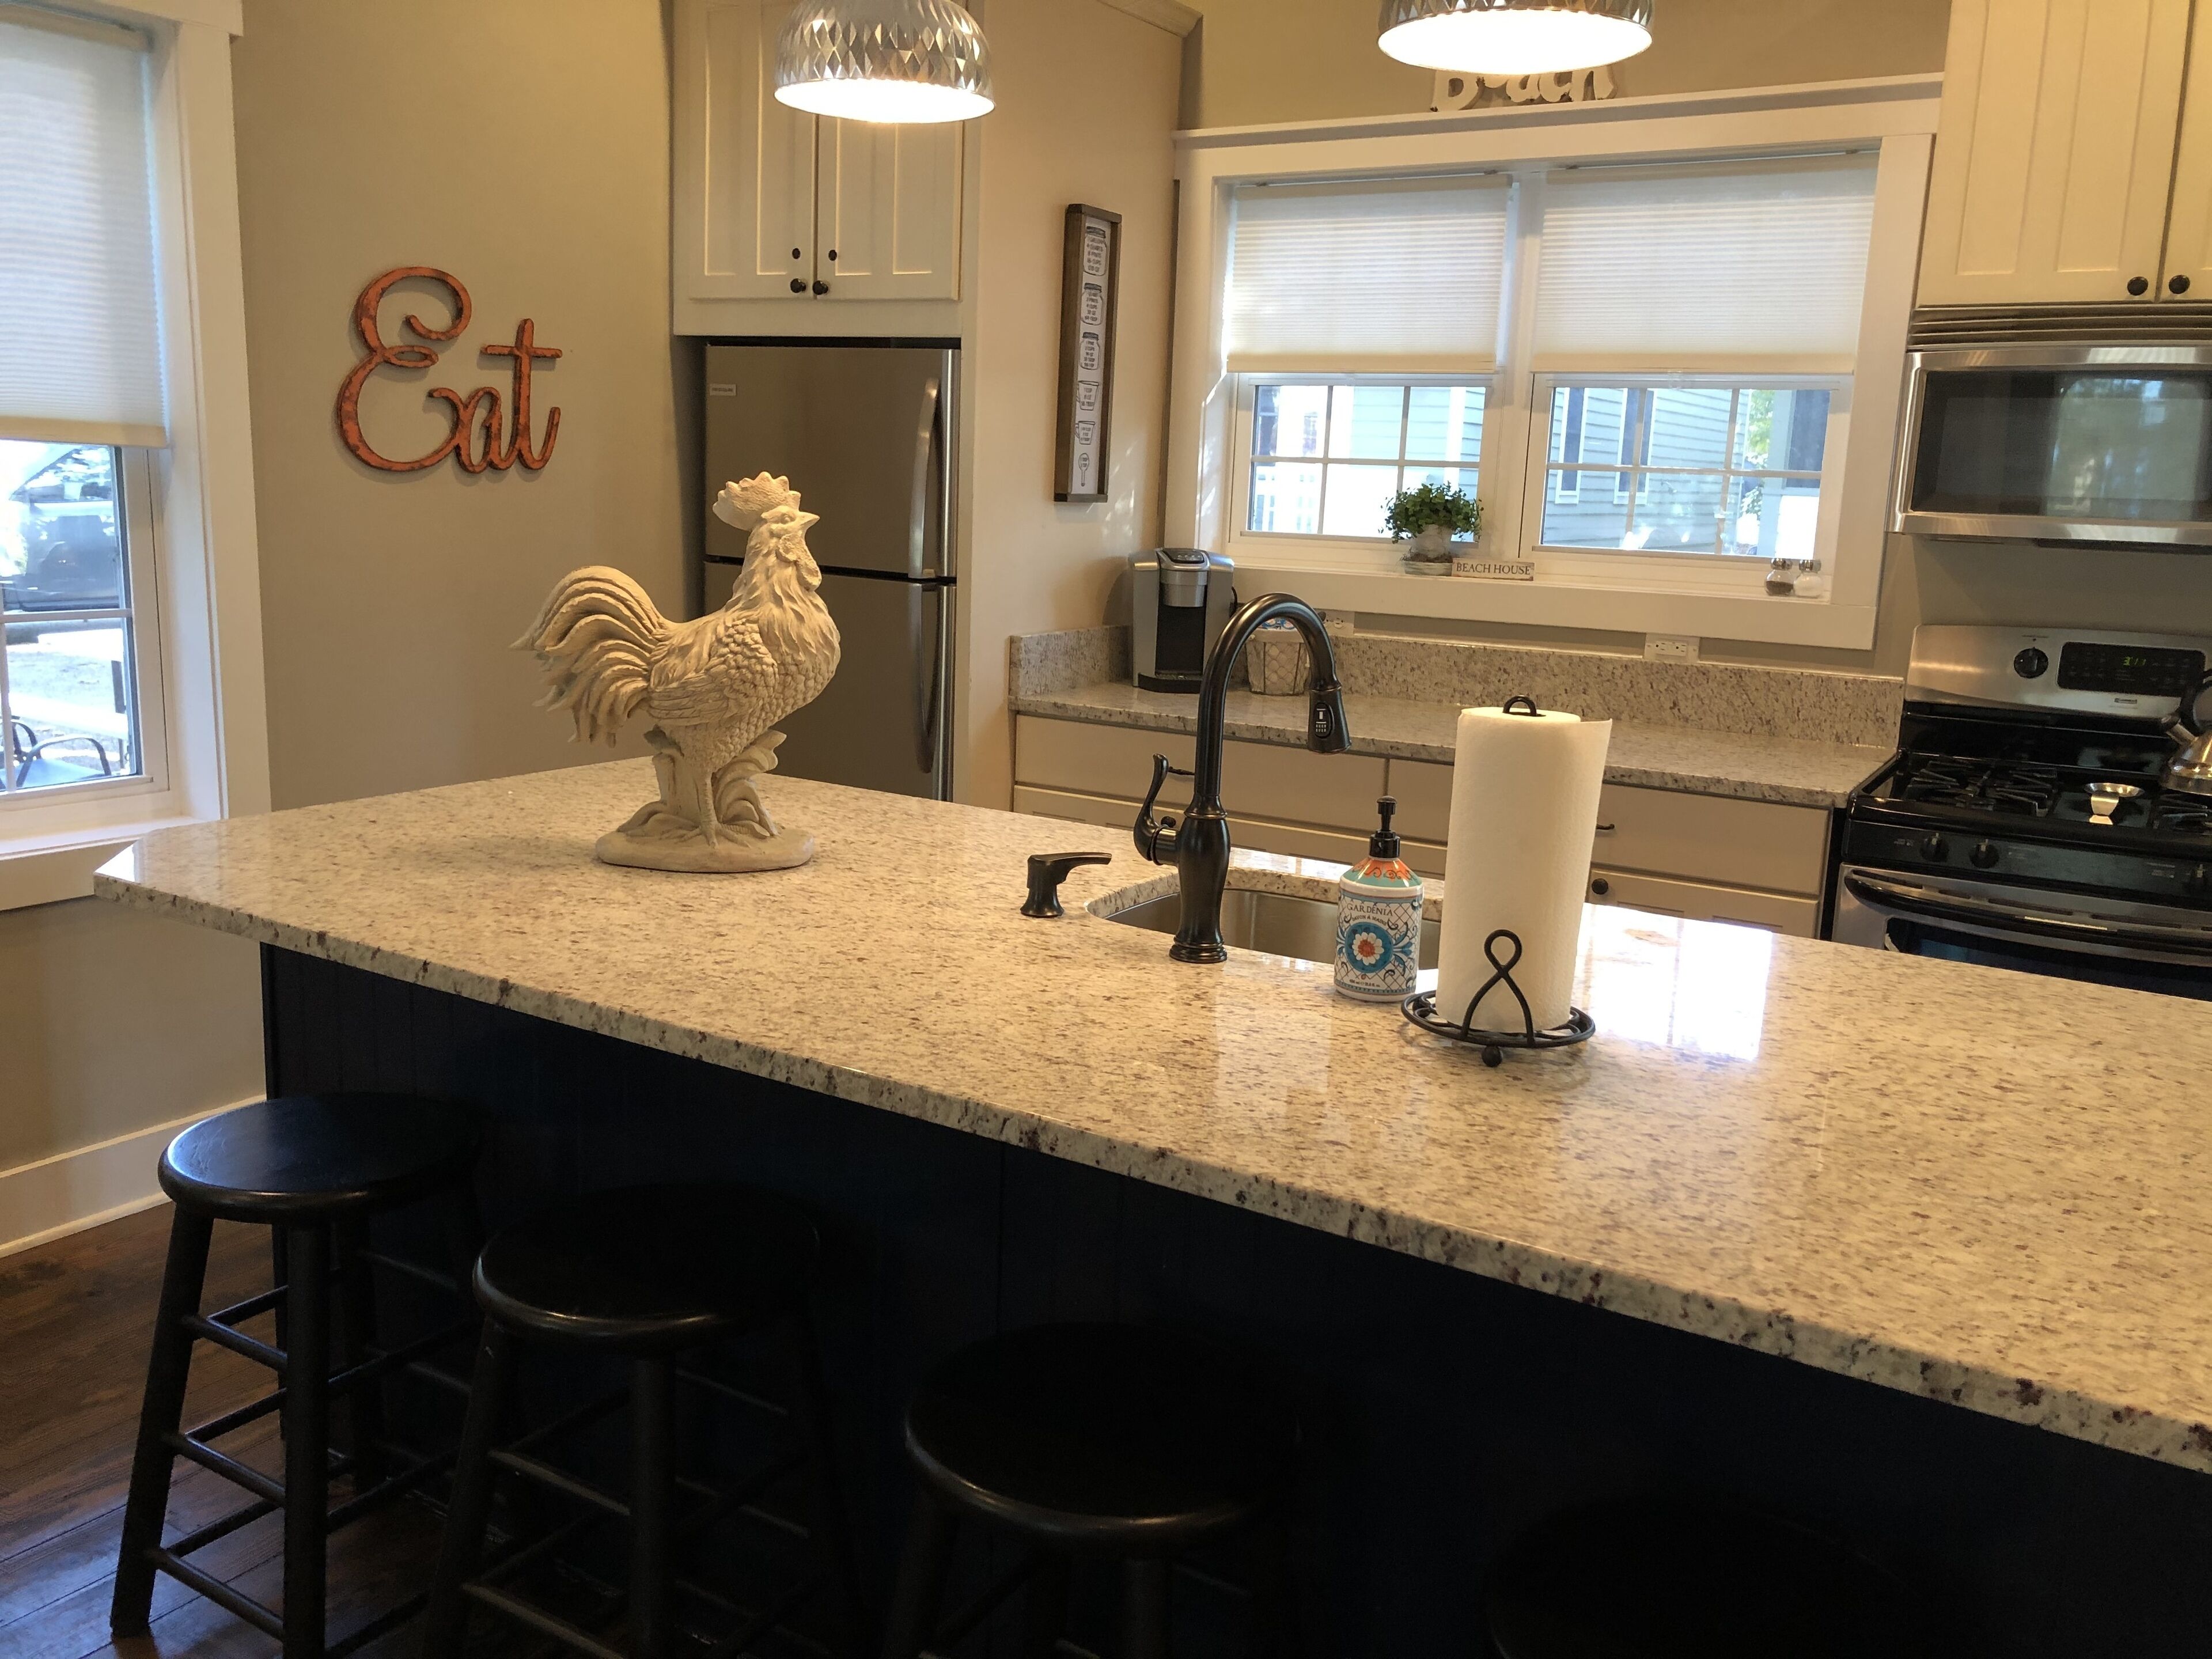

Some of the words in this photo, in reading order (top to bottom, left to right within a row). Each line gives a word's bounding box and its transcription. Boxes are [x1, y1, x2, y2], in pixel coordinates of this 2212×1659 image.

[332, 267, 562, 474] Eat
[1456, 562, 1491, 573] BEACH
[1494, 564, 1531, 575] HOUSE
[1347, 903, 1393, 916] GARDENIA
